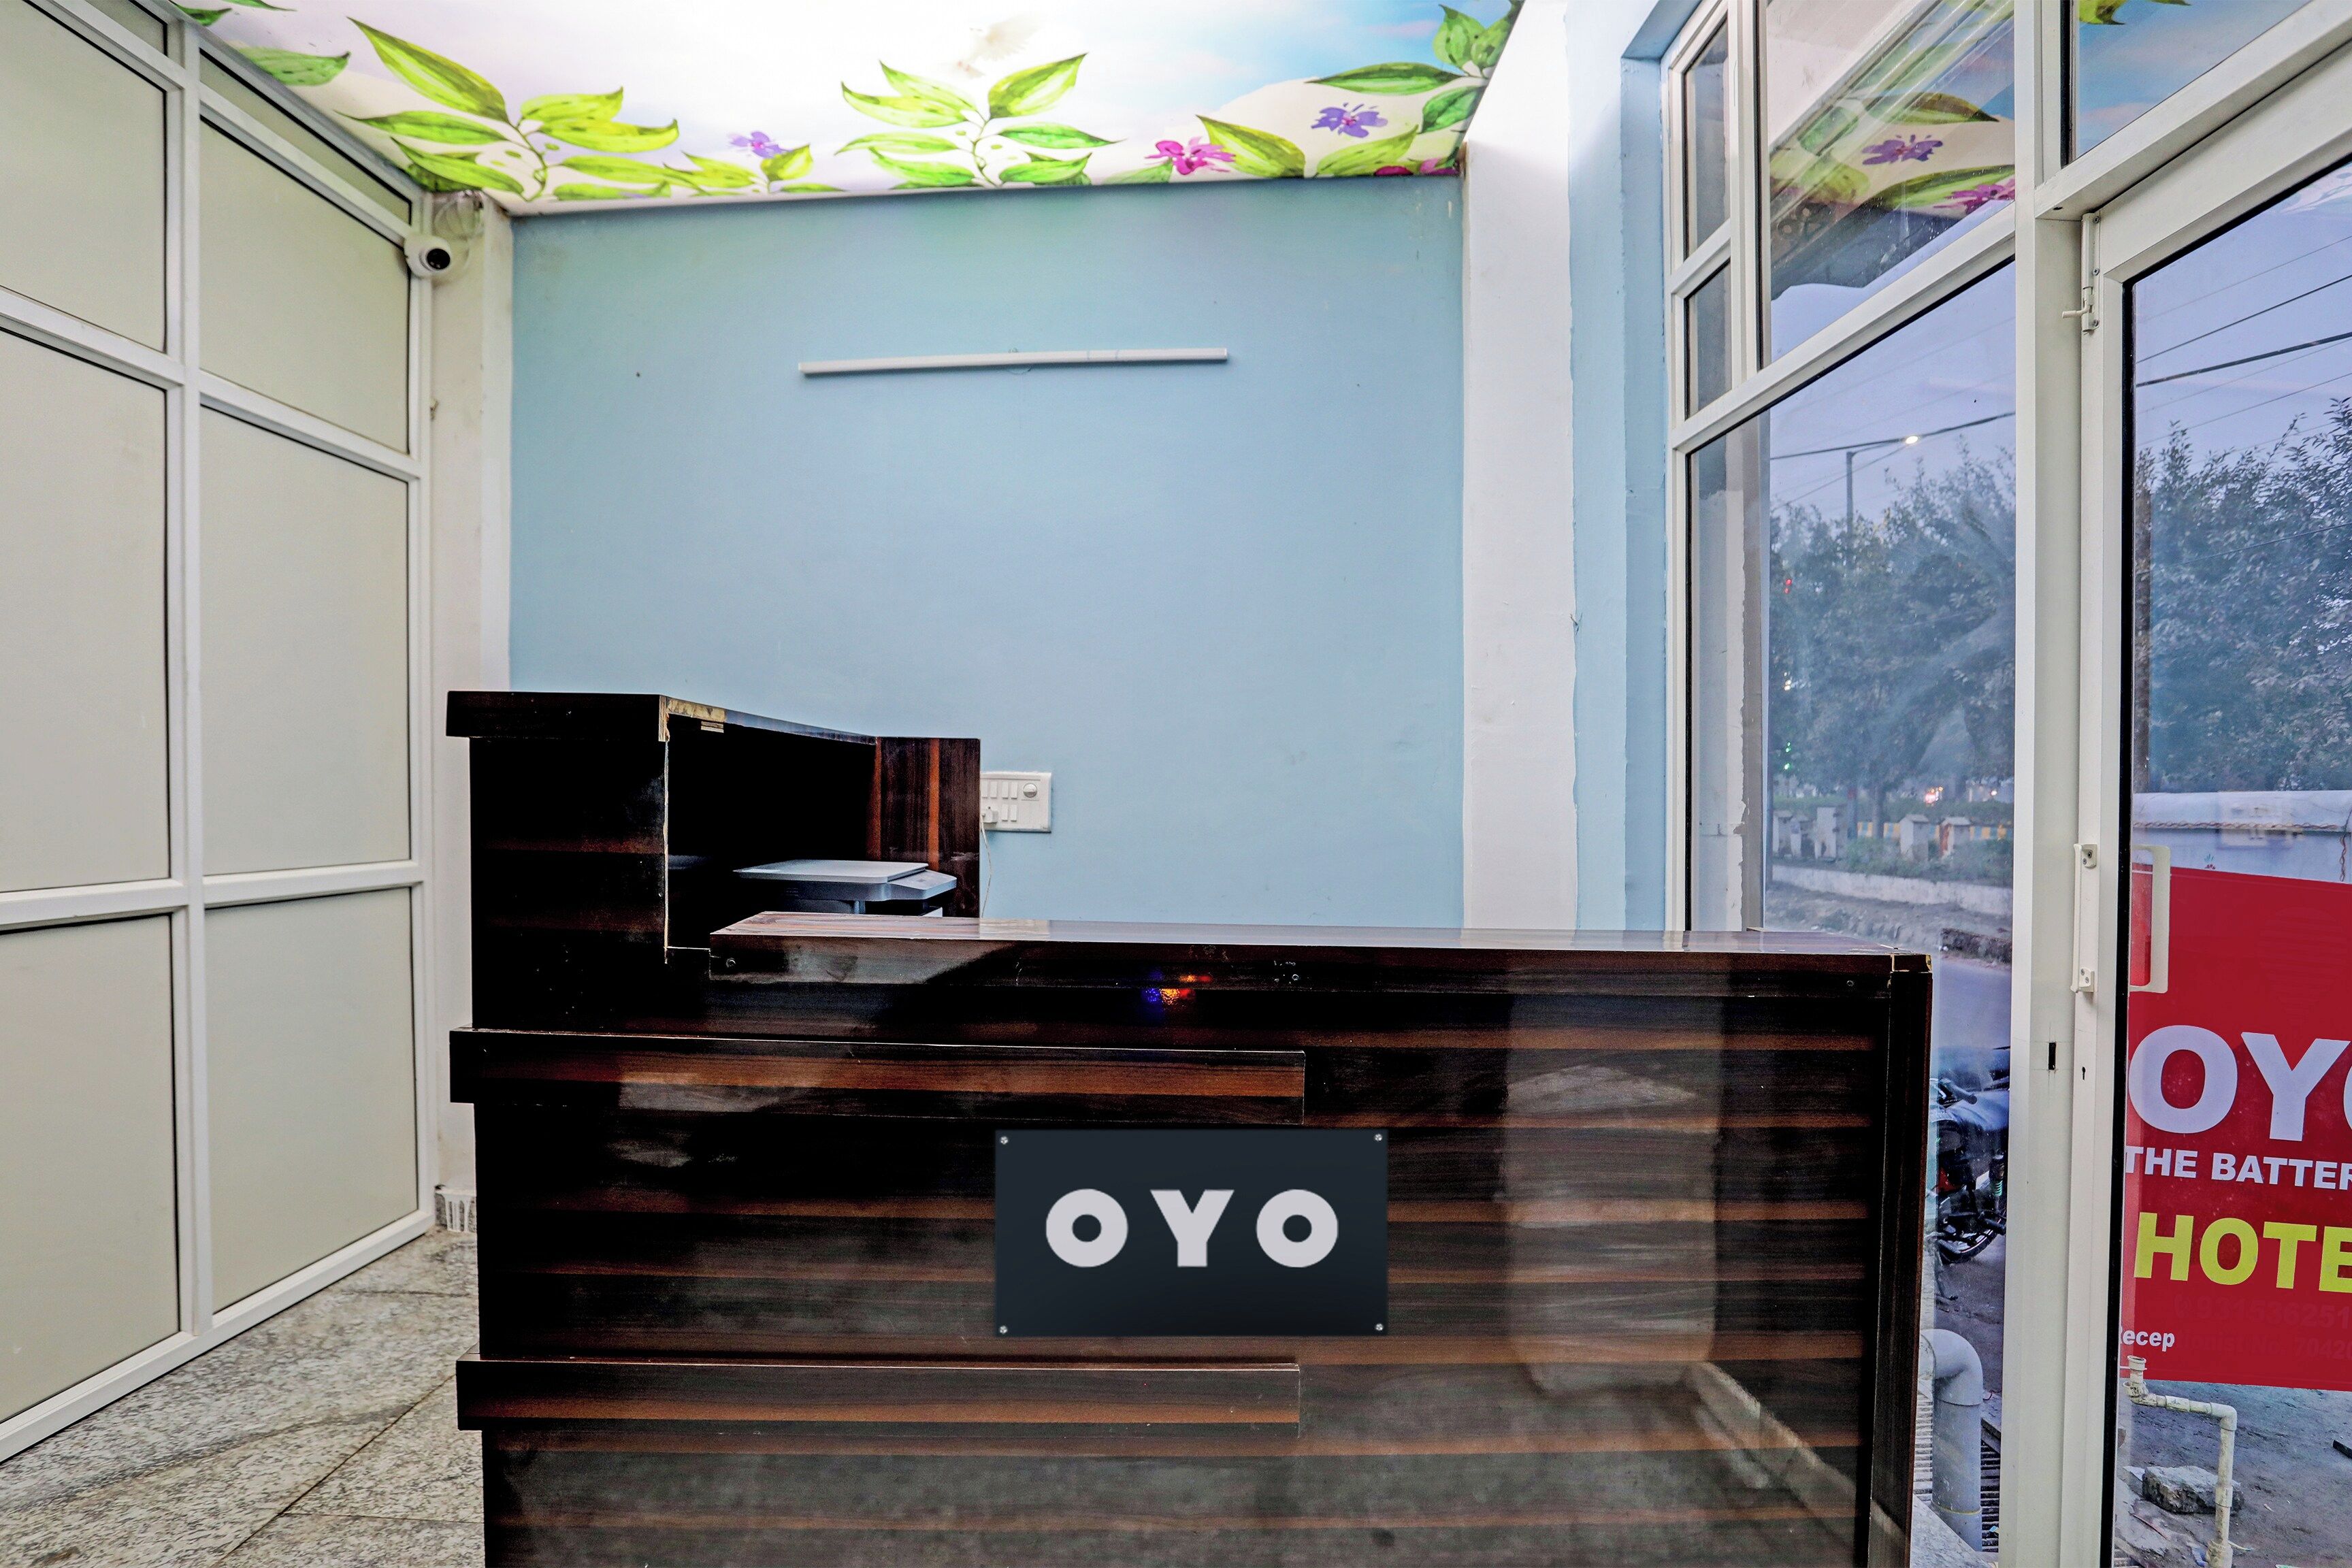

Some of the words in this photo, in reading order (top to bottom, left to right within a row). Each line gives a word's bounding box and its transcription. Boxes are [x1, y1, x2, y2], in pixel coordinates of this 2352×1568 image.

[2127, 1025, 2352, 1142] OY
[2125, 1146, 2198, 1179] THE
[1045, 1188, 1339, 1268] OYO
[2134, 1211, 2352, 1294] HOTE
[2121, 1326, 2175, 1352] ecep
